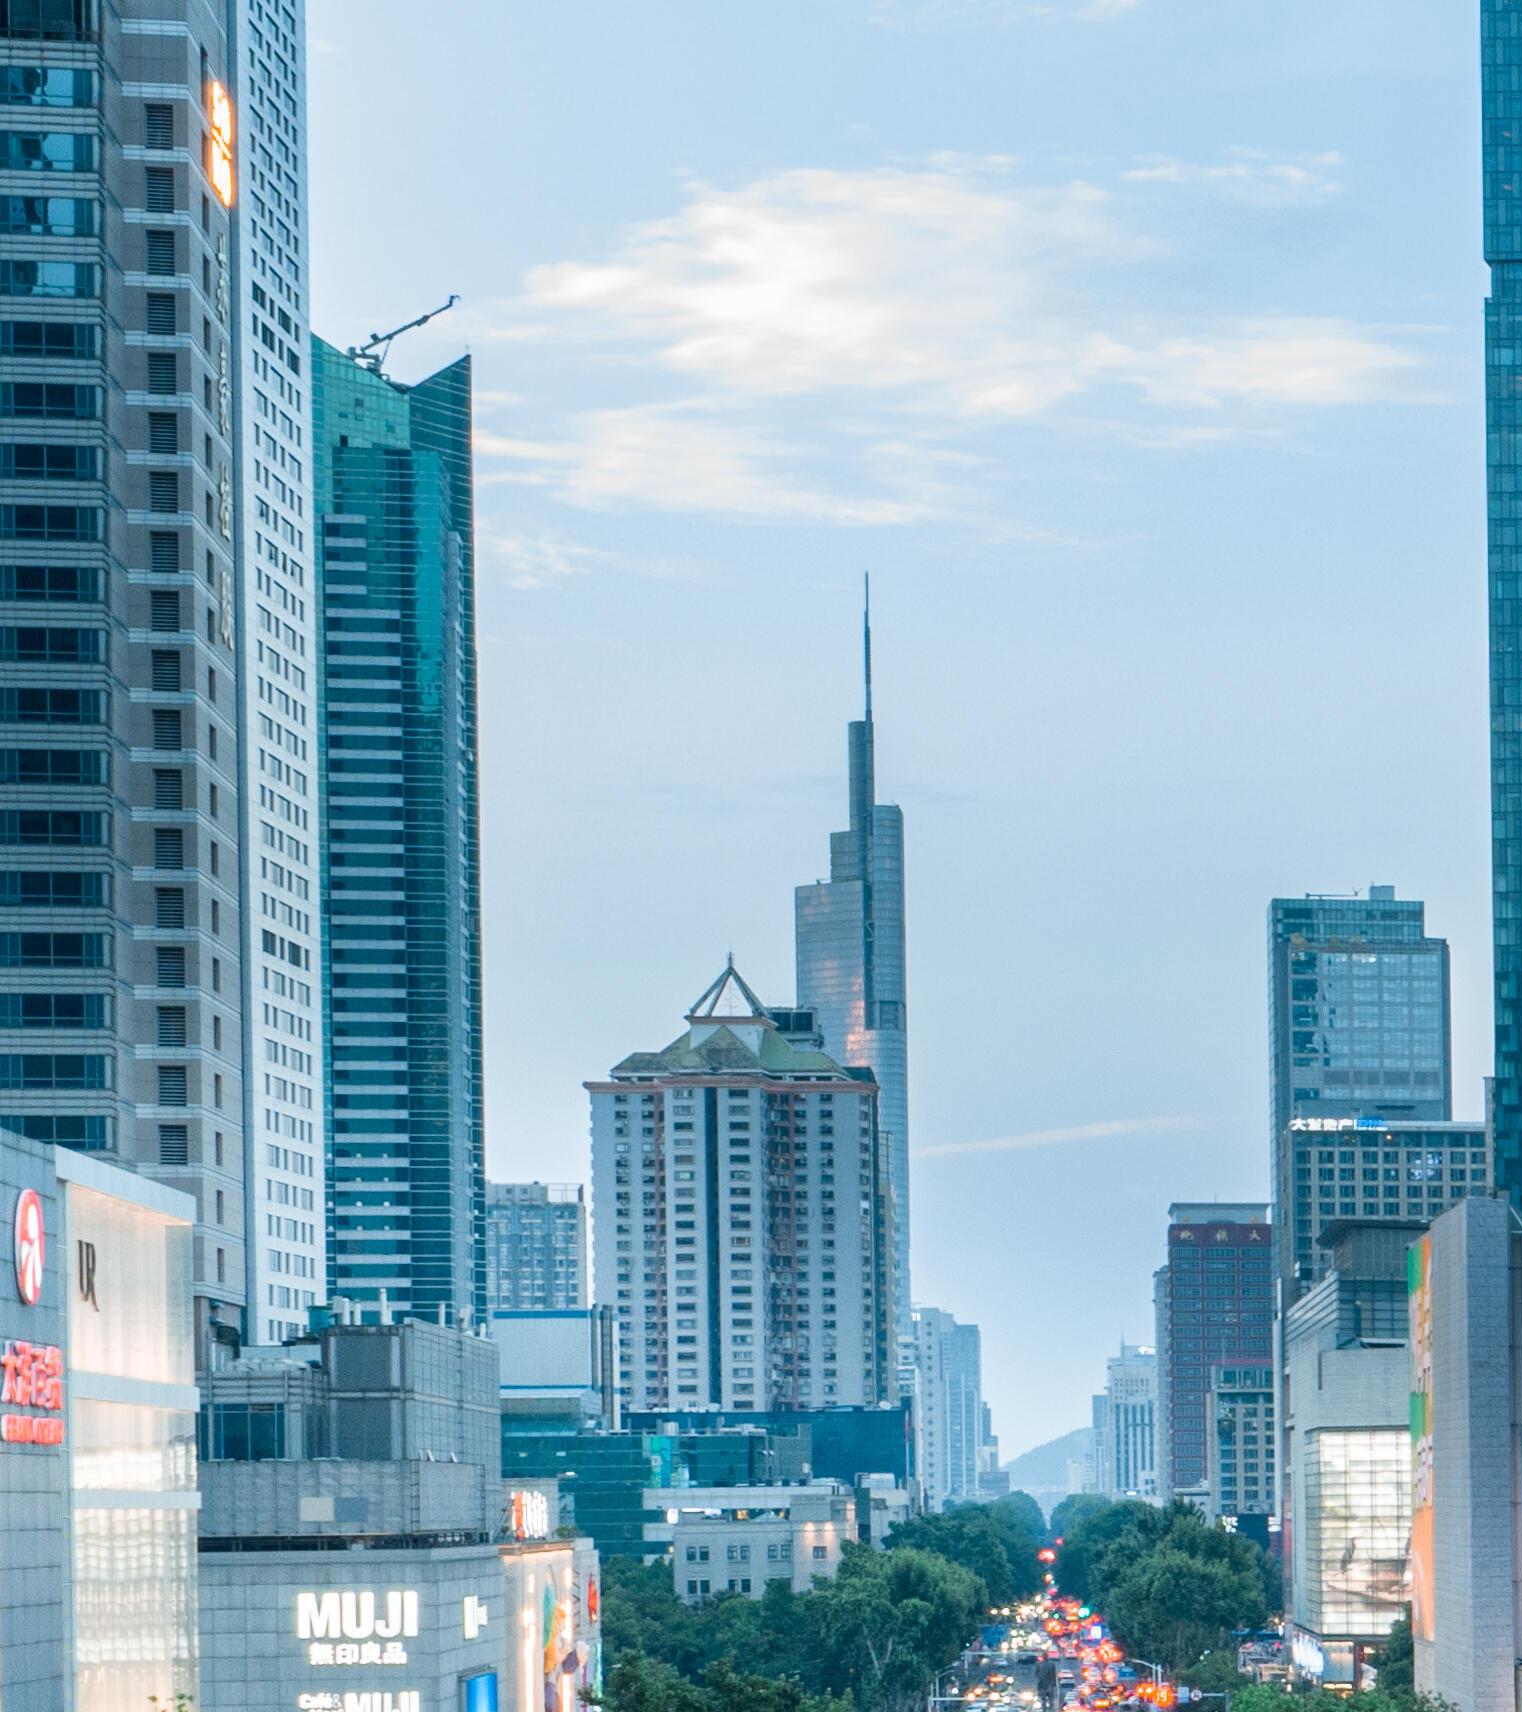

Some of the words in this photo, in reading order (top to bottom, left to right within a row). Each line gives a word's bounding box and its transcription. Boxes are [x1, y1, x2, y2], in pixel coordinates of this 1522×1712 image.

[298, 1591, 418, 1639] MUJI
[309, 1642, 407, 1665] 無印良品
